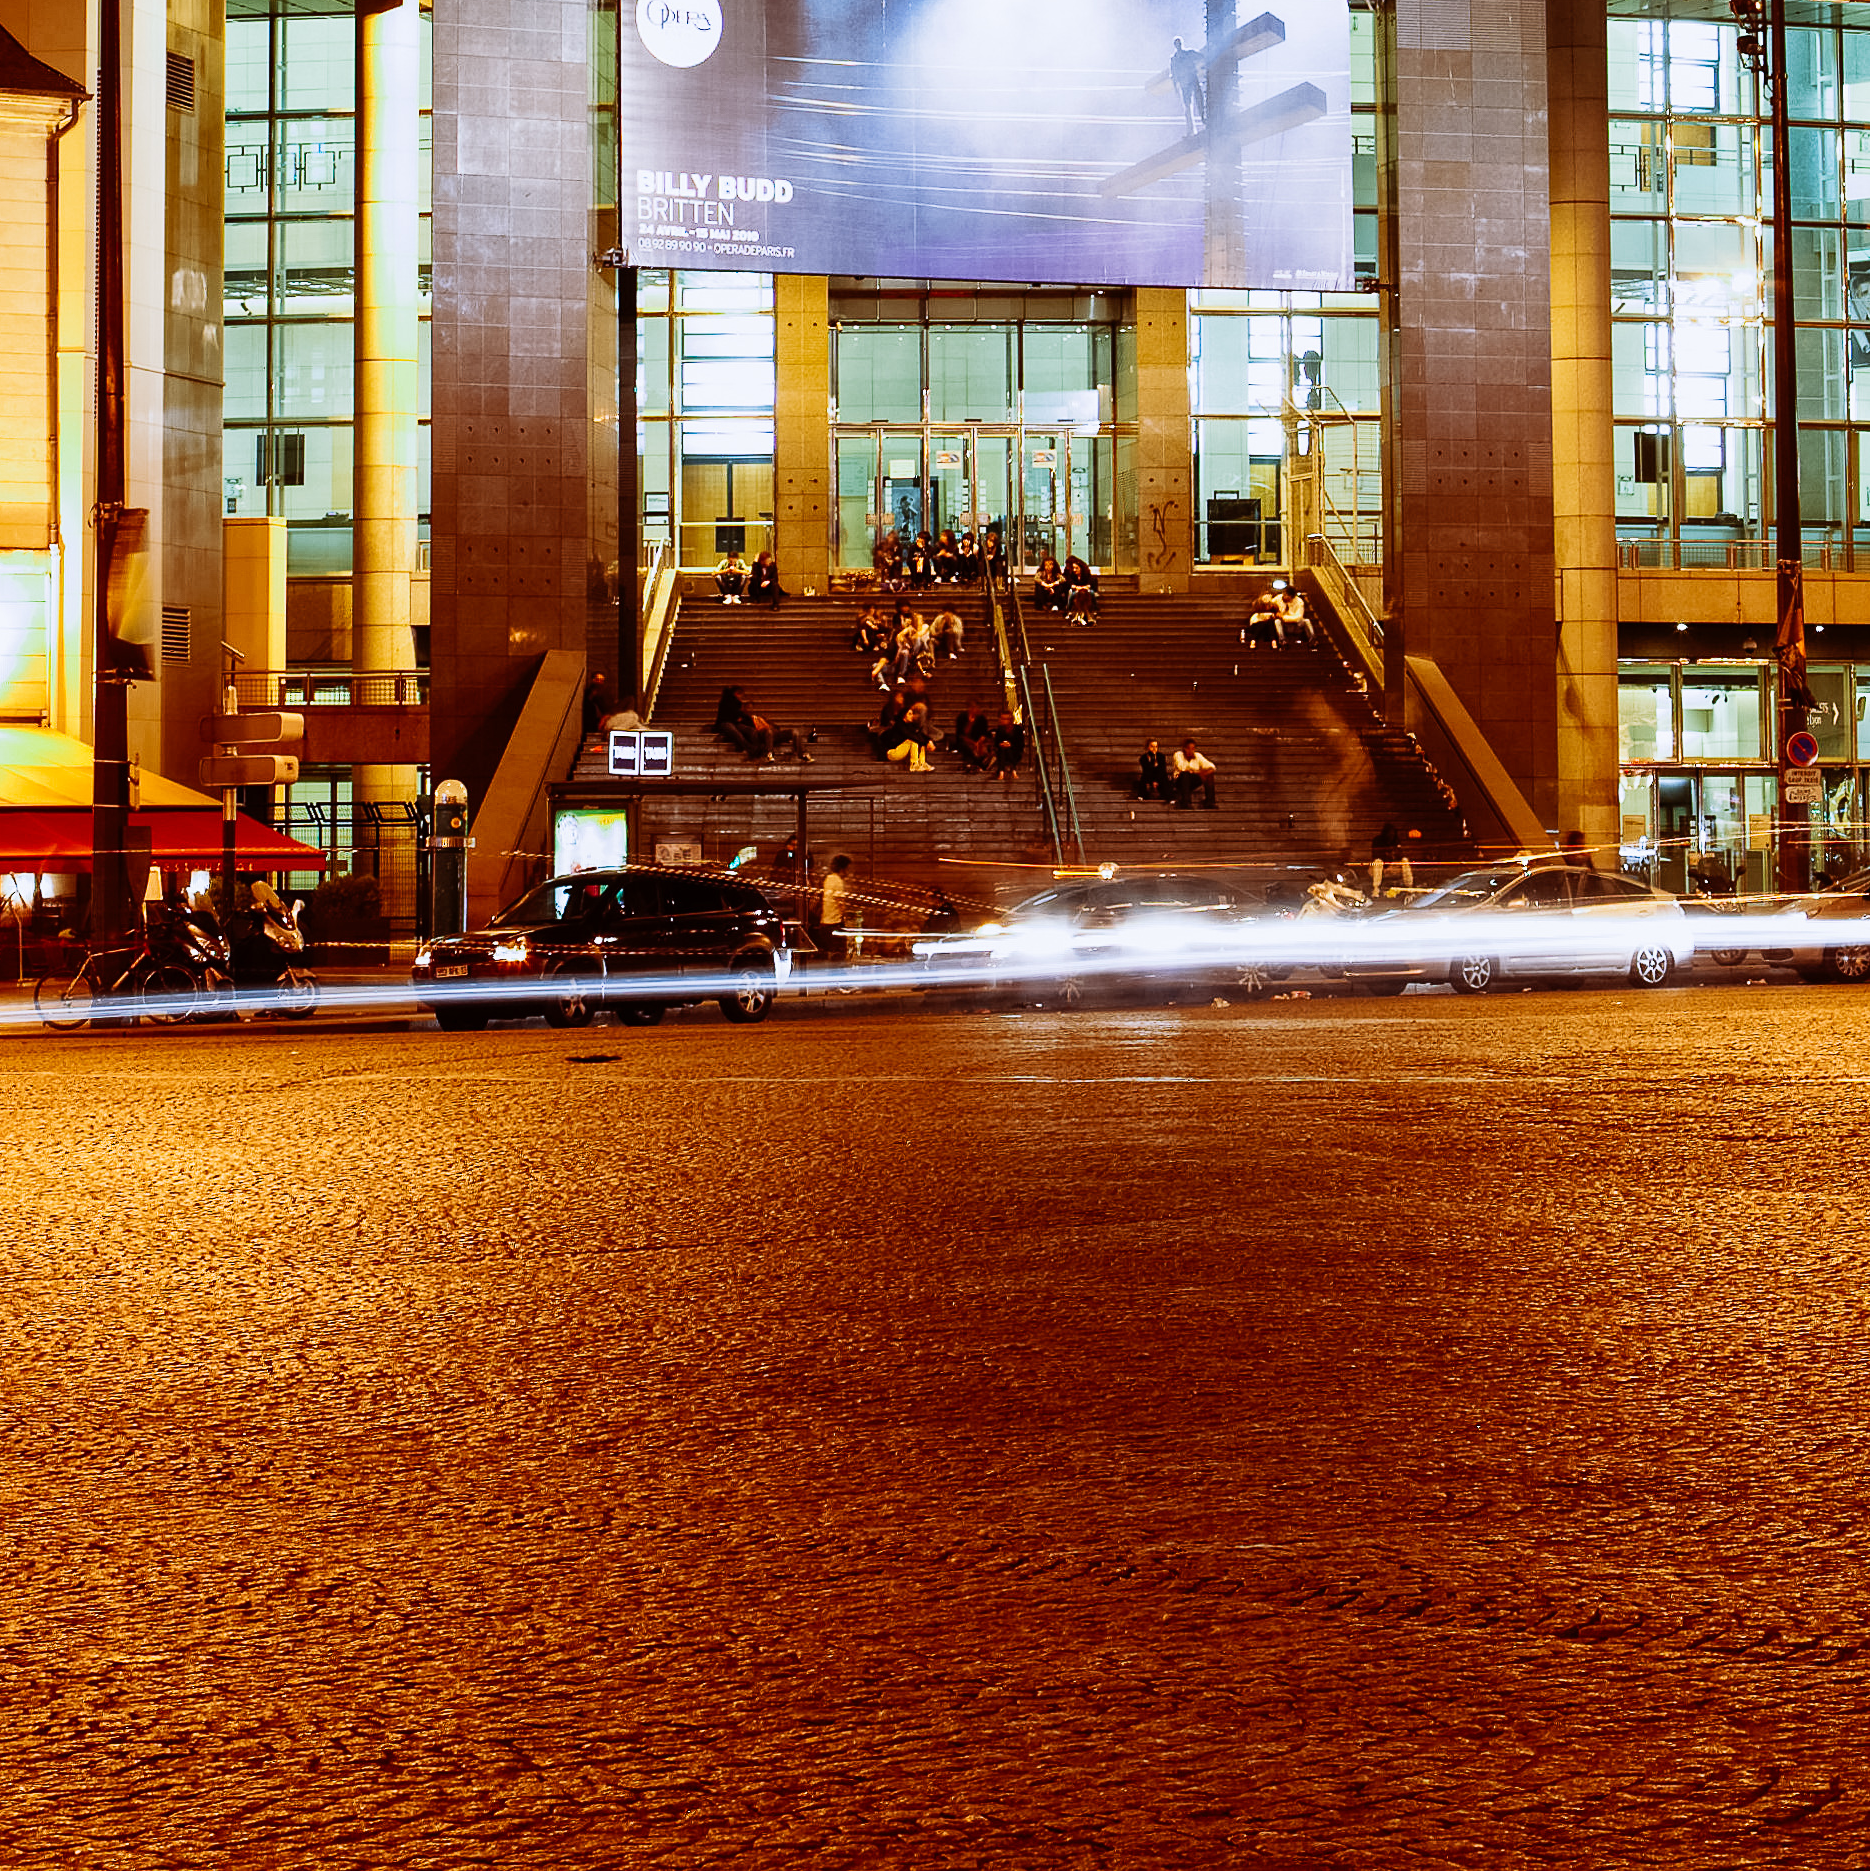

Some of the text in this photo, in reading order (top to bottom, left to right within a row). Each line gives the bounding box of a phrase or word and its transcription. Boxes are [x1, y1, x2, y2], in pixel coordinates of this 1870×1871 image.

[636, 169, 794, 203] BILLY BUDD
[637, 196, 734, 226] BRITTEN
[709, 228, 731, 241] MAI
[637, 237, 652, 248] 08
[652, 238, 665, 249] 92
[665, 239, 679, 250] 89
[679, 240, 692, 252] 90
[692, 241, 707, 253] 90
[714, 243, 795, 259] OPERADEPARIS.FR
